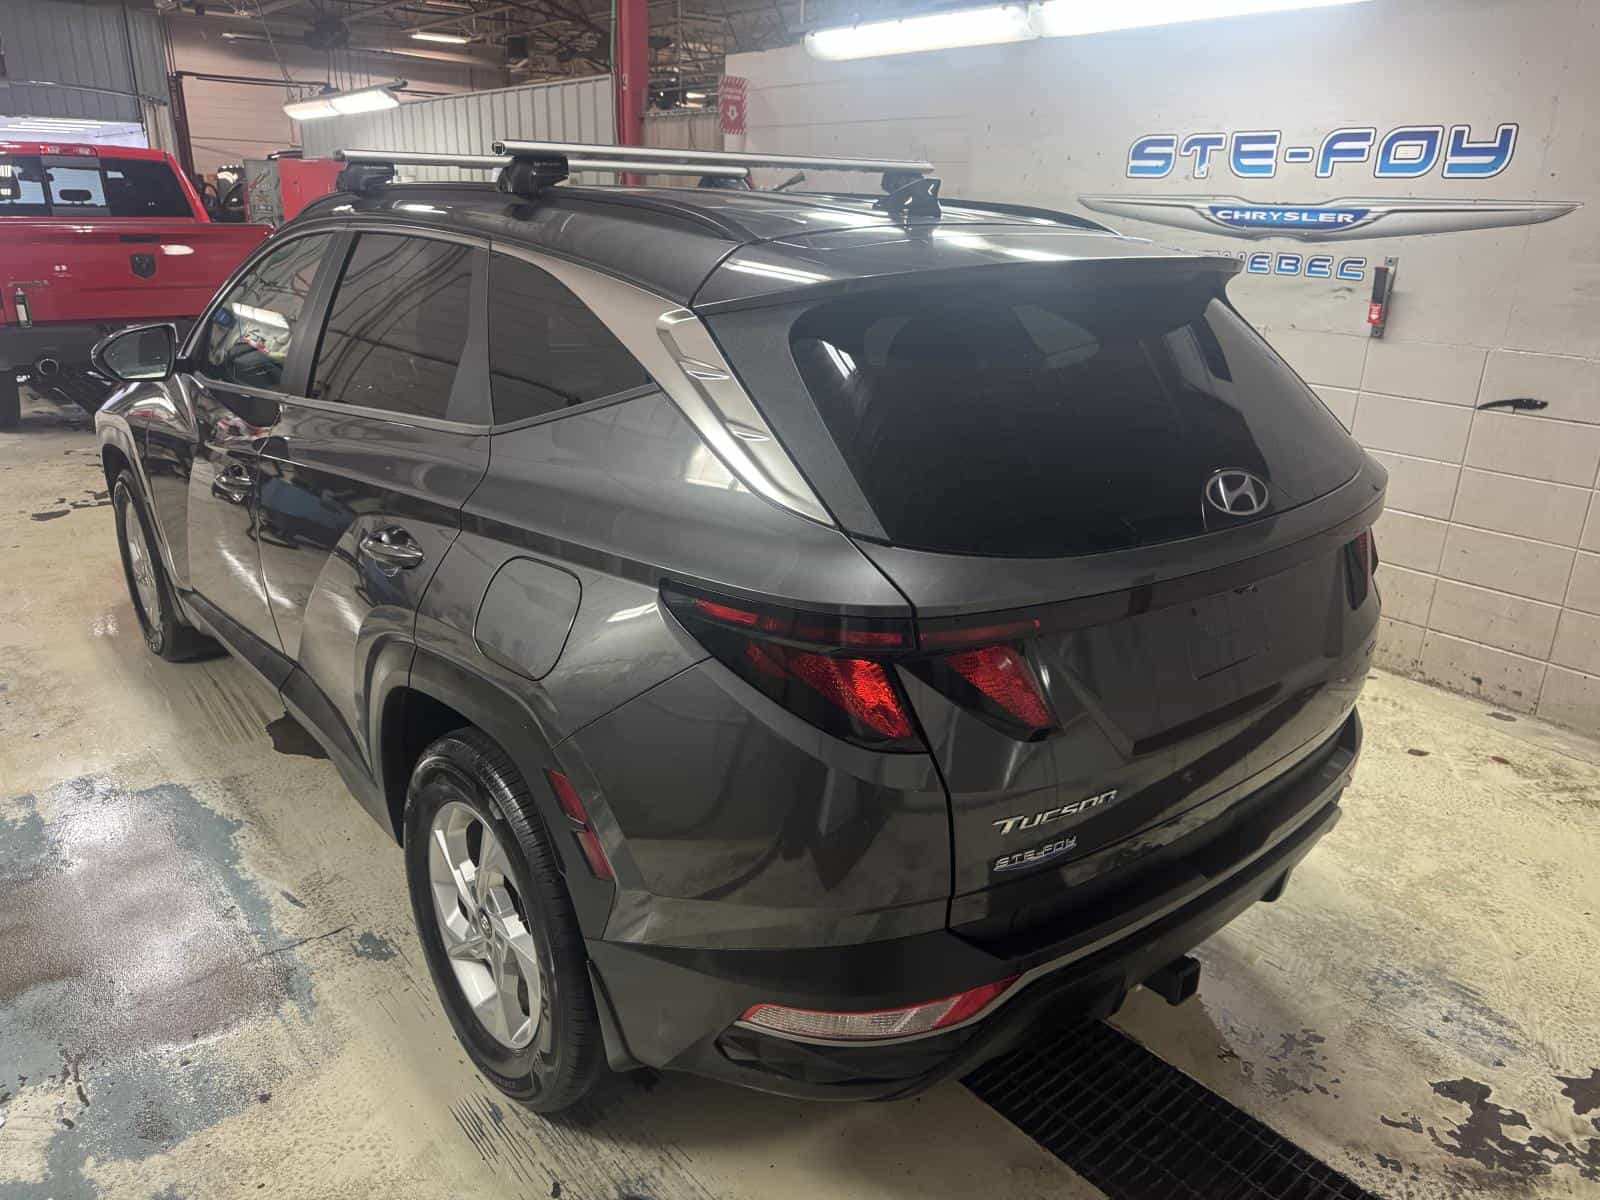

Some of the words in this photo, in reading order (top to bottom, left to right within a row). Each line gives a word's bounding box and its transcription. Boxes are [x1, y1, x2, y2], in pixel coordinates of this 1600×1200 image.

[1126, 123, 1519, 179] STE-FOY
[1216, 210, 1354, 223] CHRYSLER
[1198, 250, 1367, 280] EBEC
[992, 790, 1117, 835] TUCSON
